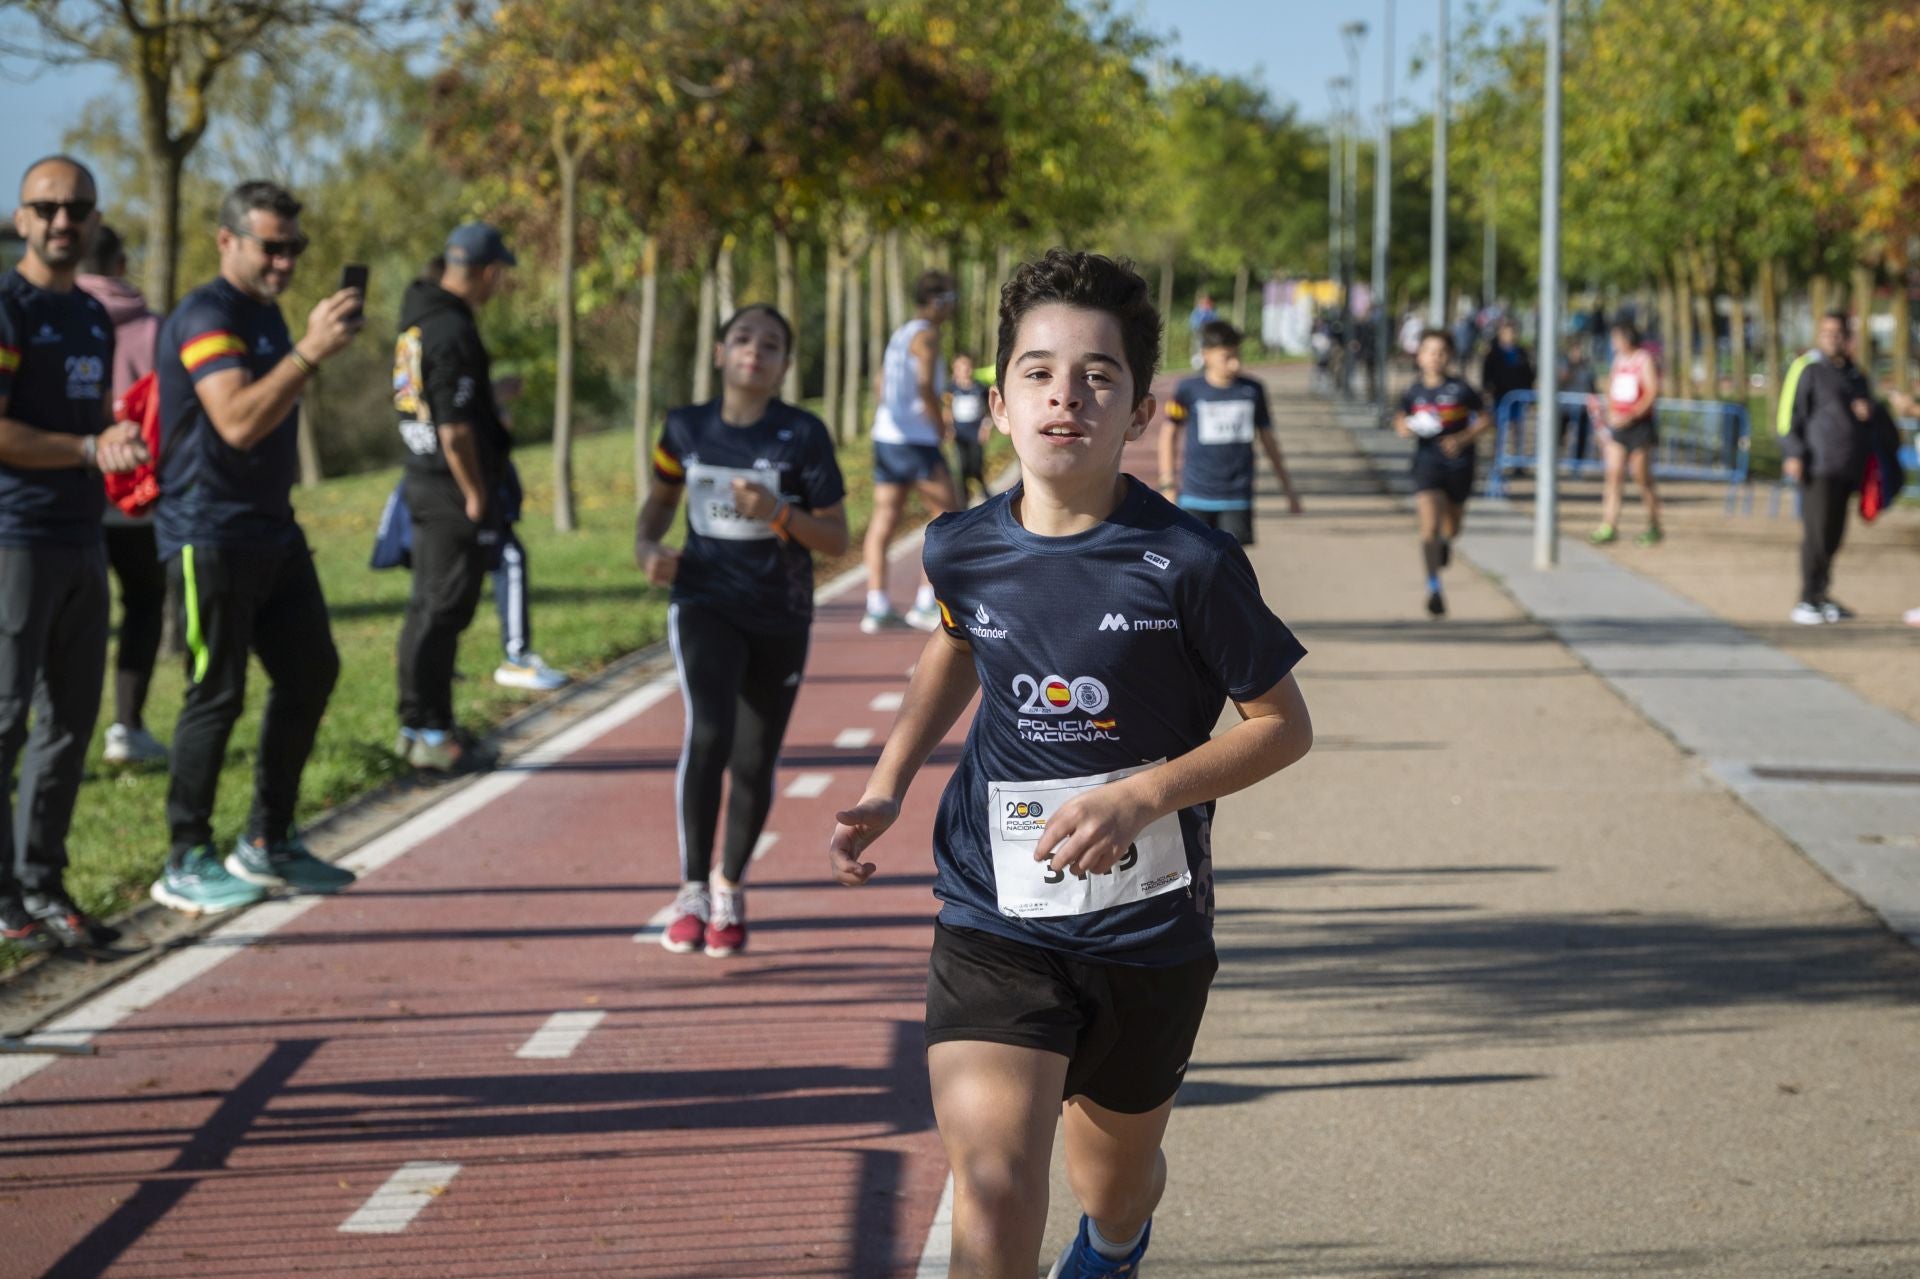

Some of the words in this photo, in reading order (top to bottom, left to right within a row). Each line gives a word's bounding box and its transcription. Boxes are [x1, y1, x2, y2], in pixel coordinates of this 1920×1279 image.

[1012, 673, 1110, 715] 200
[1017, 719, 1097, 732] POLICIA
[1019, 730, 1120, 743] NACIONAL
[1006, 801, 1044, 819] 200
